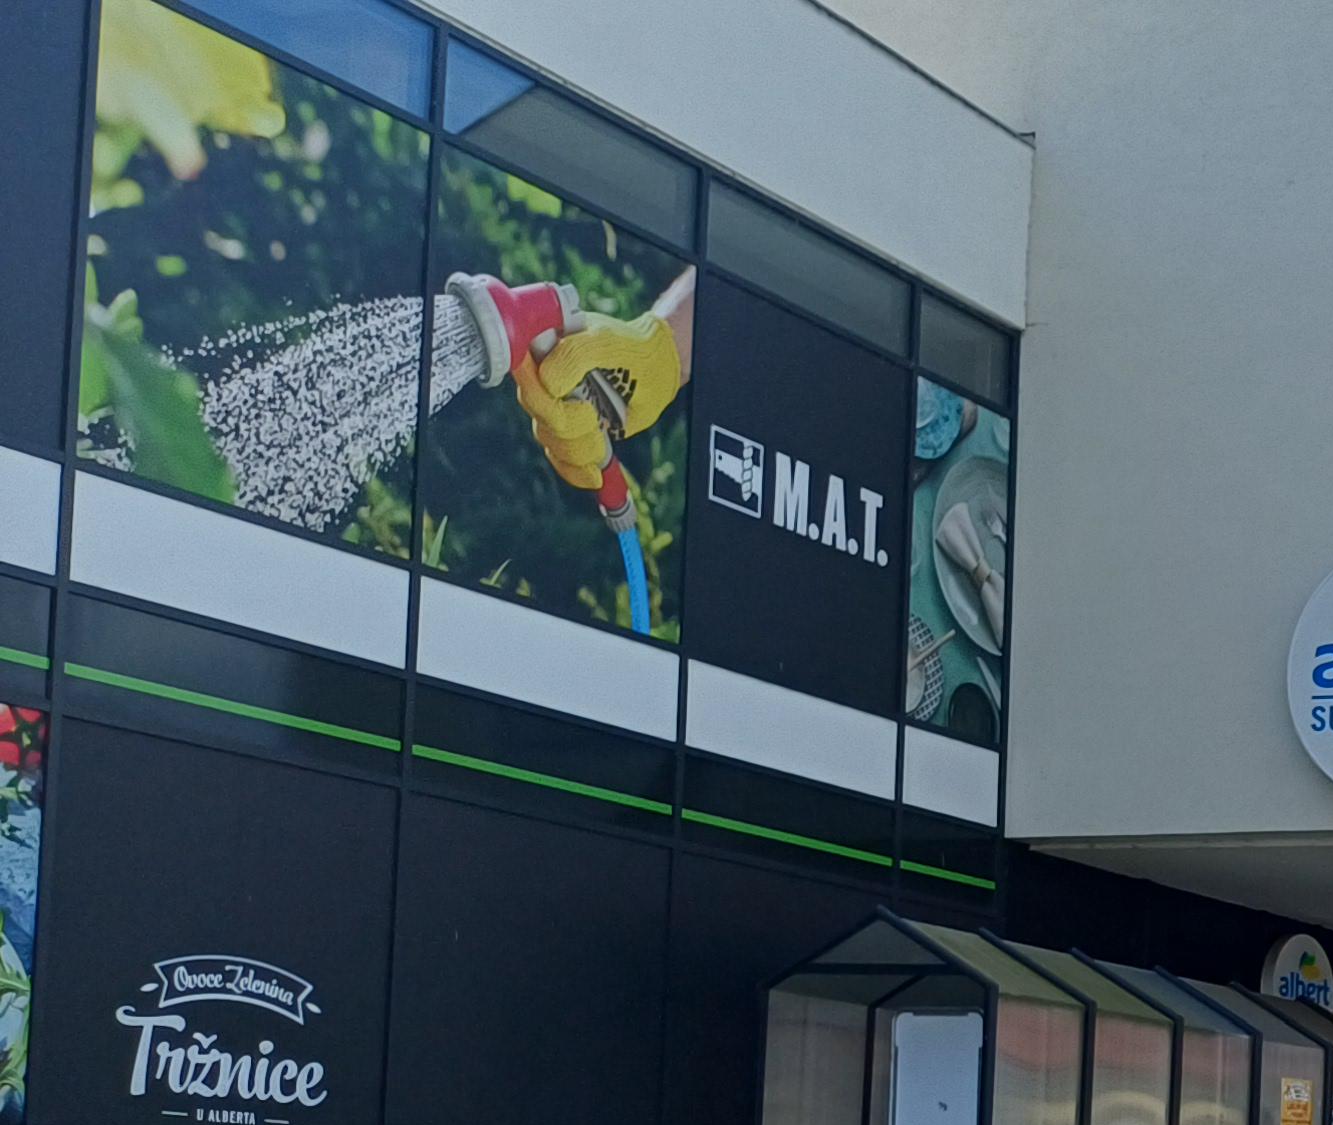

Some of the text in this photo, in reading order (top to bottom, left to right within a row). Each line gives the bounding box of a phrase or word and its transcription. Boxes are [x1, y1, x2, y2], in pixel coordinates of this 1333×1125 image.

[773, 451, 888, 567] M.A.T.
[174, 965, 294, 1006] Ovoce Zelenina
[1279, 972, 1330, 1006] albert
[116, 1006, 328, 1106] Tržnice
[196, 1108, 256, 1125] U ALBERTA
